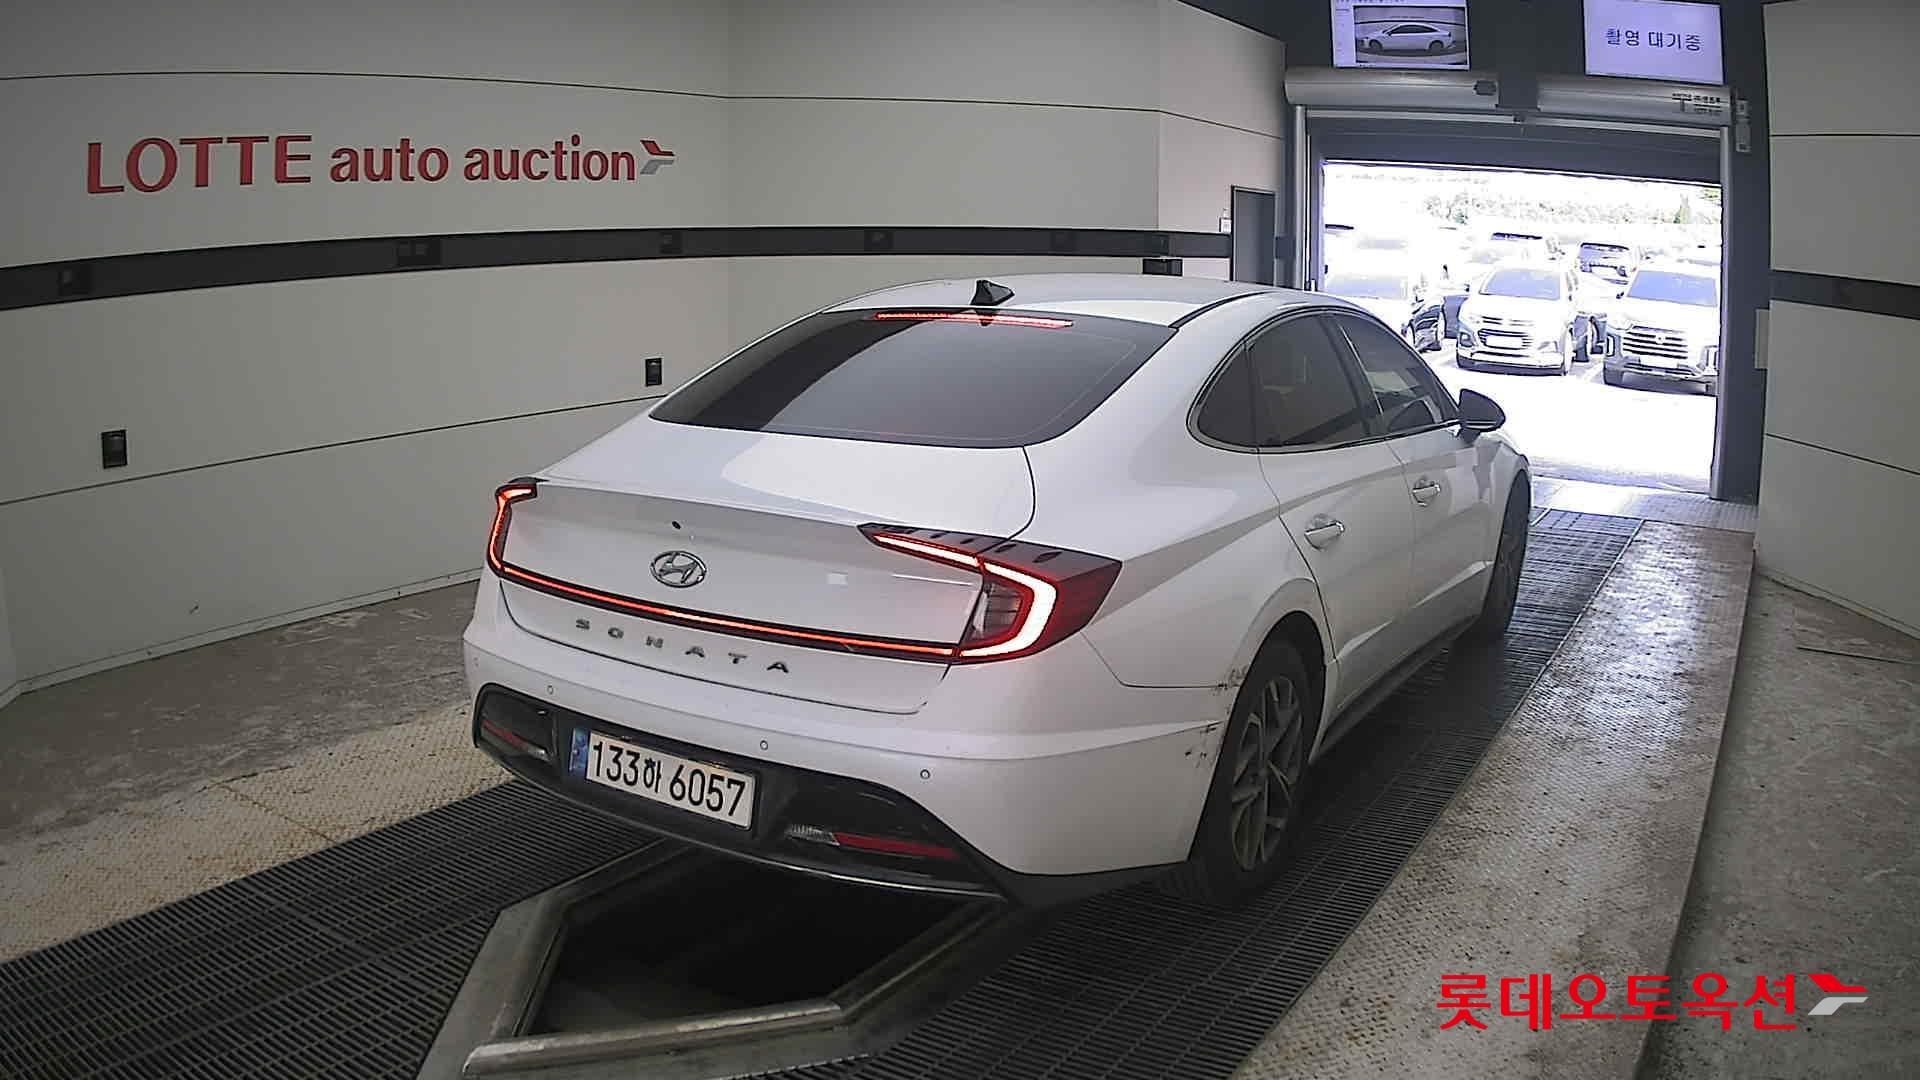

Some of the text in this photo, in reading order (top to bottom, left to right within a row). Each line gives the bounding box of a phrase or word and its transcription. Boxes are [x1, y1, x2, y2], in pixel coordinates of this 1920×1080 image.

[1648, 31, 1700, 51] 대기중
[86, 134, 636, 194] LOTTE auto auction
[575, 618, 790, 674] SONATA
[593, 740, 746, 817] 133하 6057
